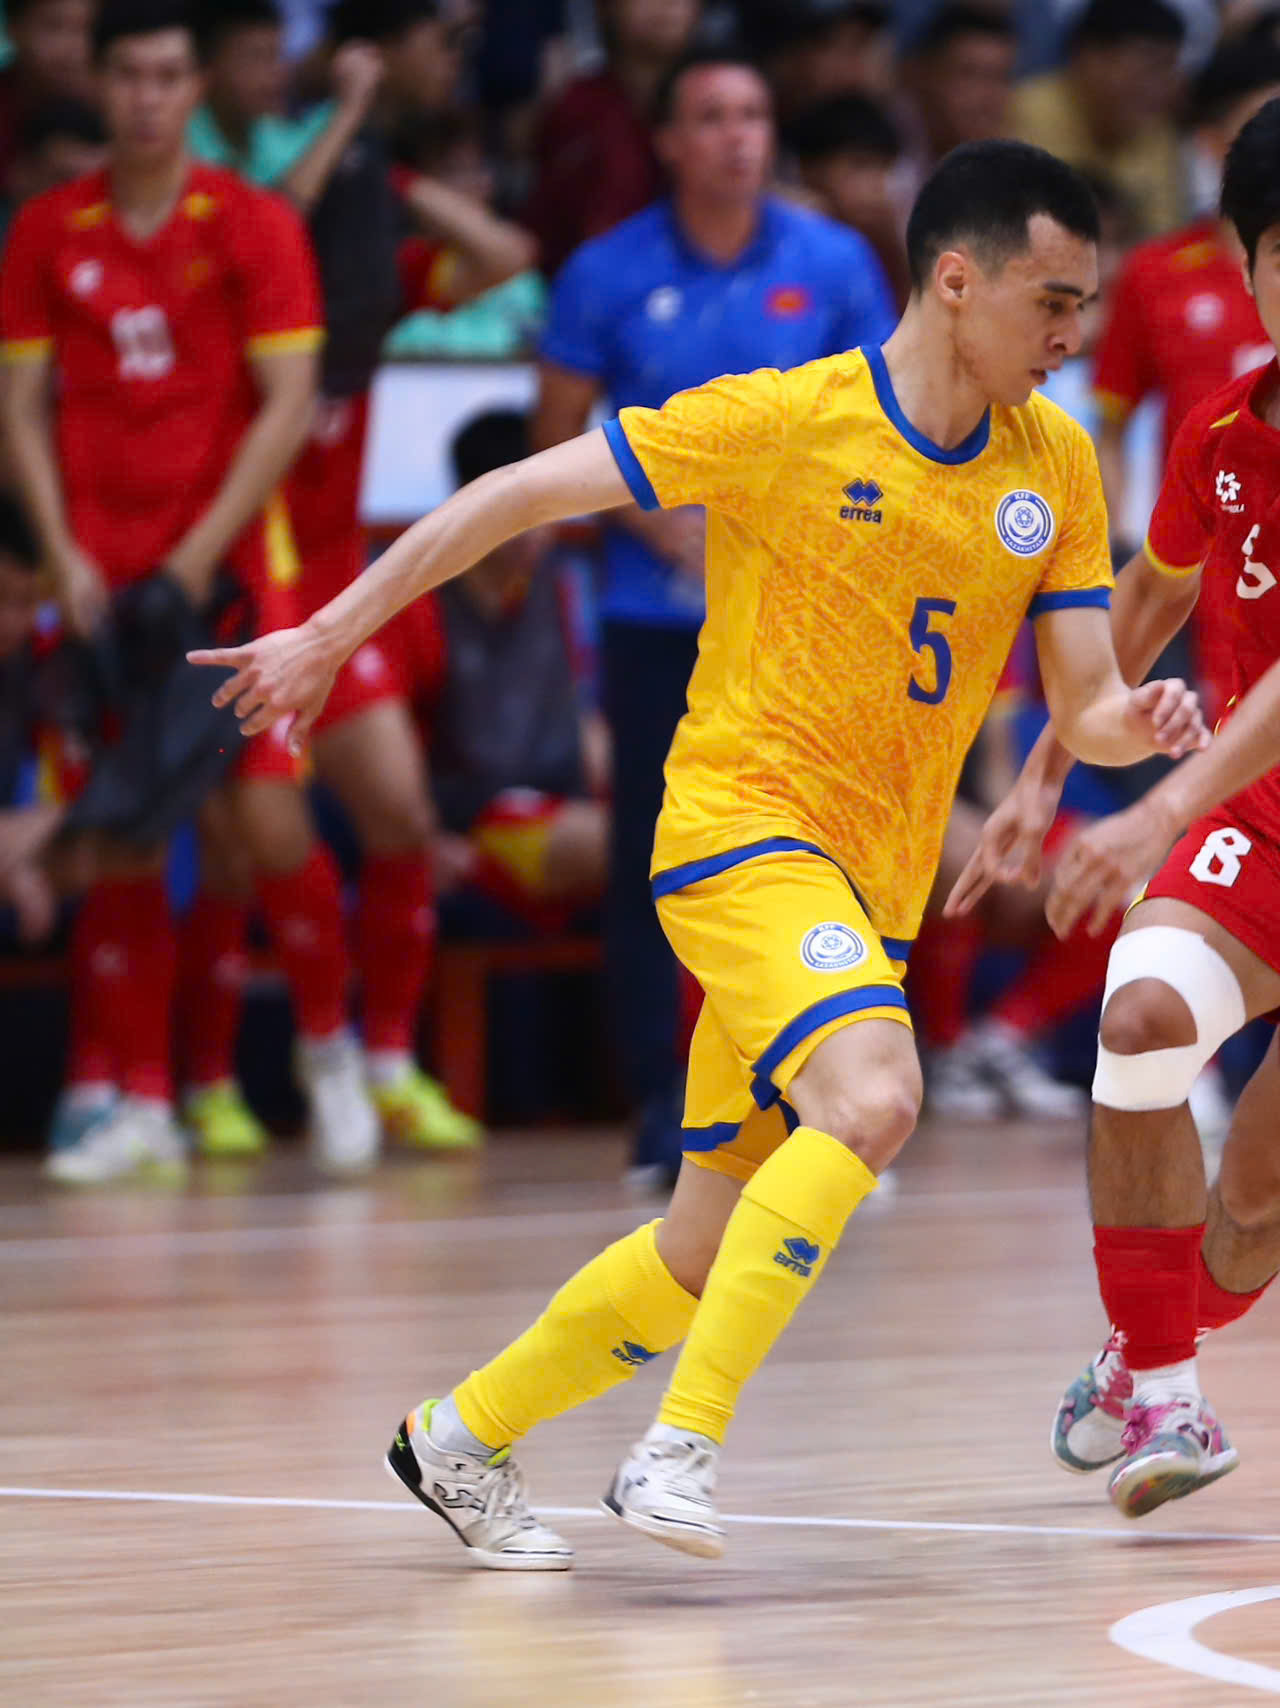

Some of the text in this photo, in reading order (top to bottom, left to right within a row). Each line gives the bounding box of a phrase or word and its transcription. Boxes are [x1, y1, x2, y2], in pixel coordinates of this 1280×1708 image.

[840, 505, 882, 523] errea
[907, 596, 957, 705] 5
[1188, 826, 1252, 888] 8
